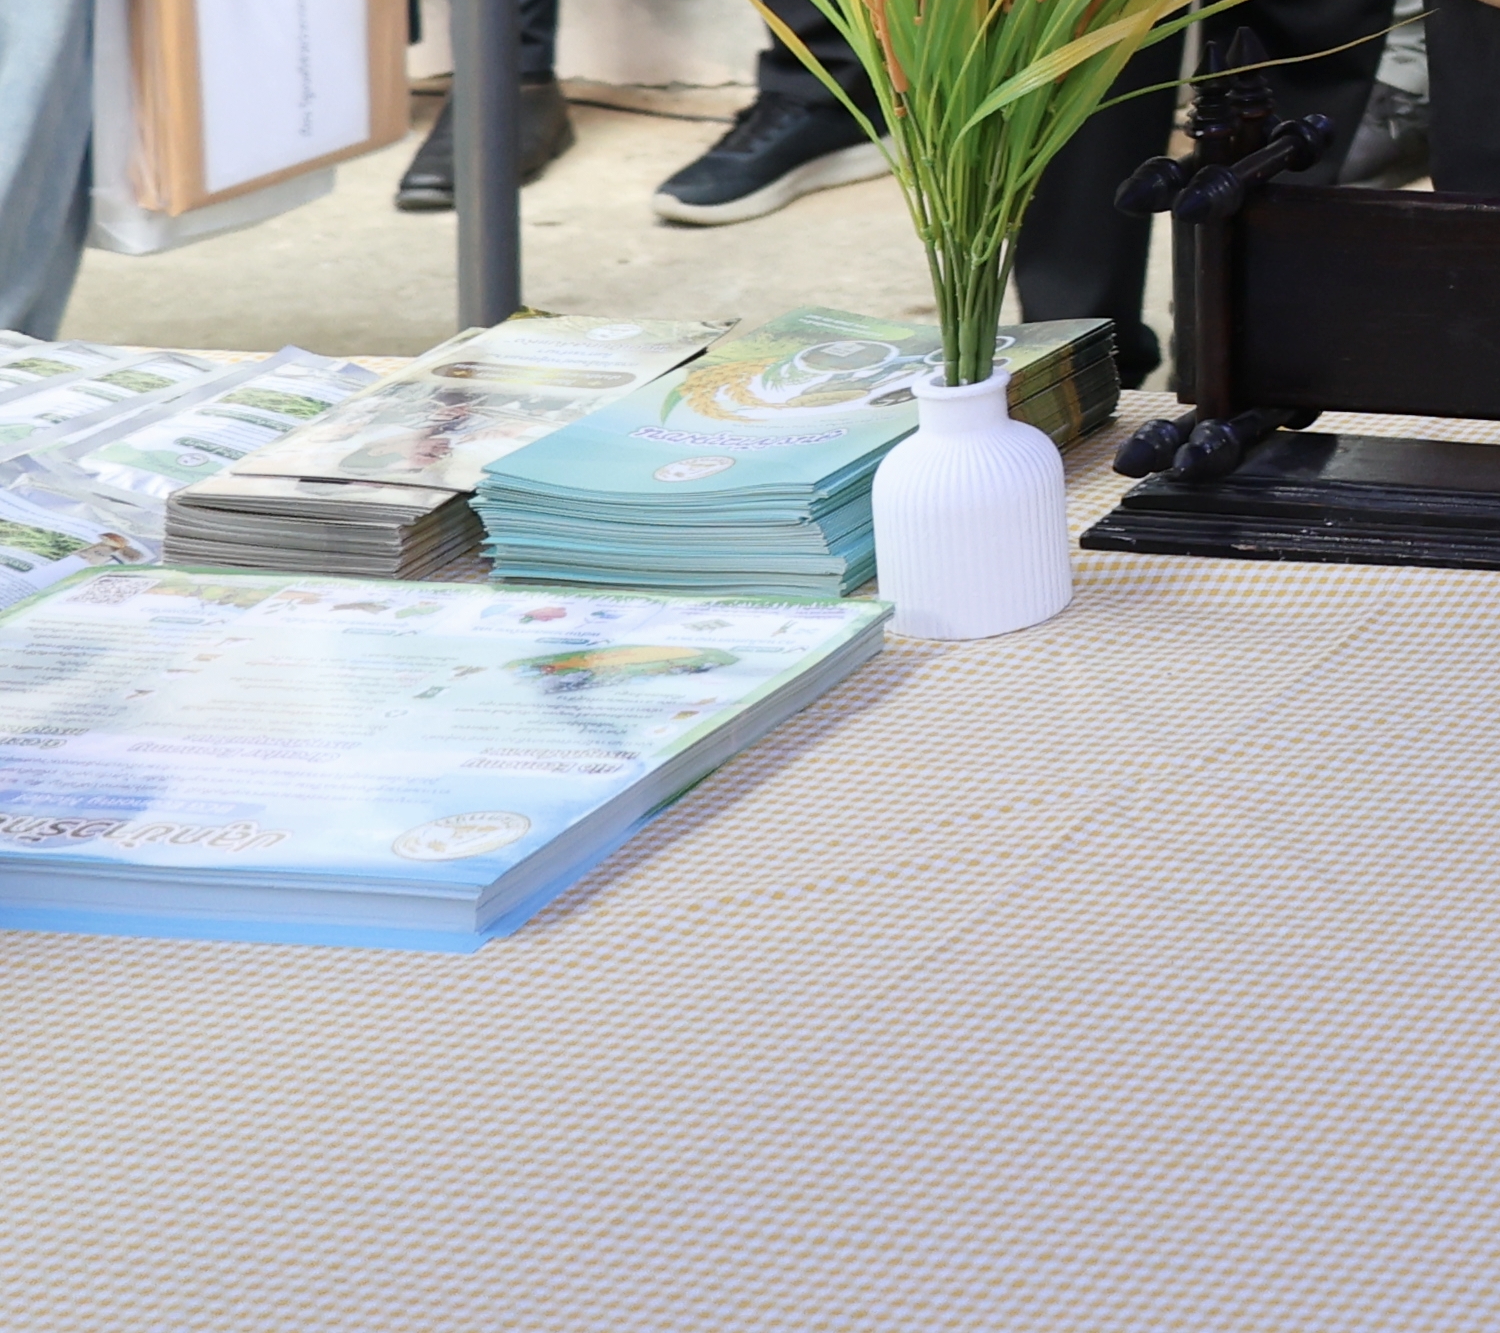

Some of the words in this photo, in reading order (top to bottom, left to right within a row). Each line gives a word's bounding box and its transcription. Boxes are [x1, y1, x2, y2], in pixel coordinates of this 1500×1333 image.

[0, 817, 289, 853] ปลูกข้าวรัก
